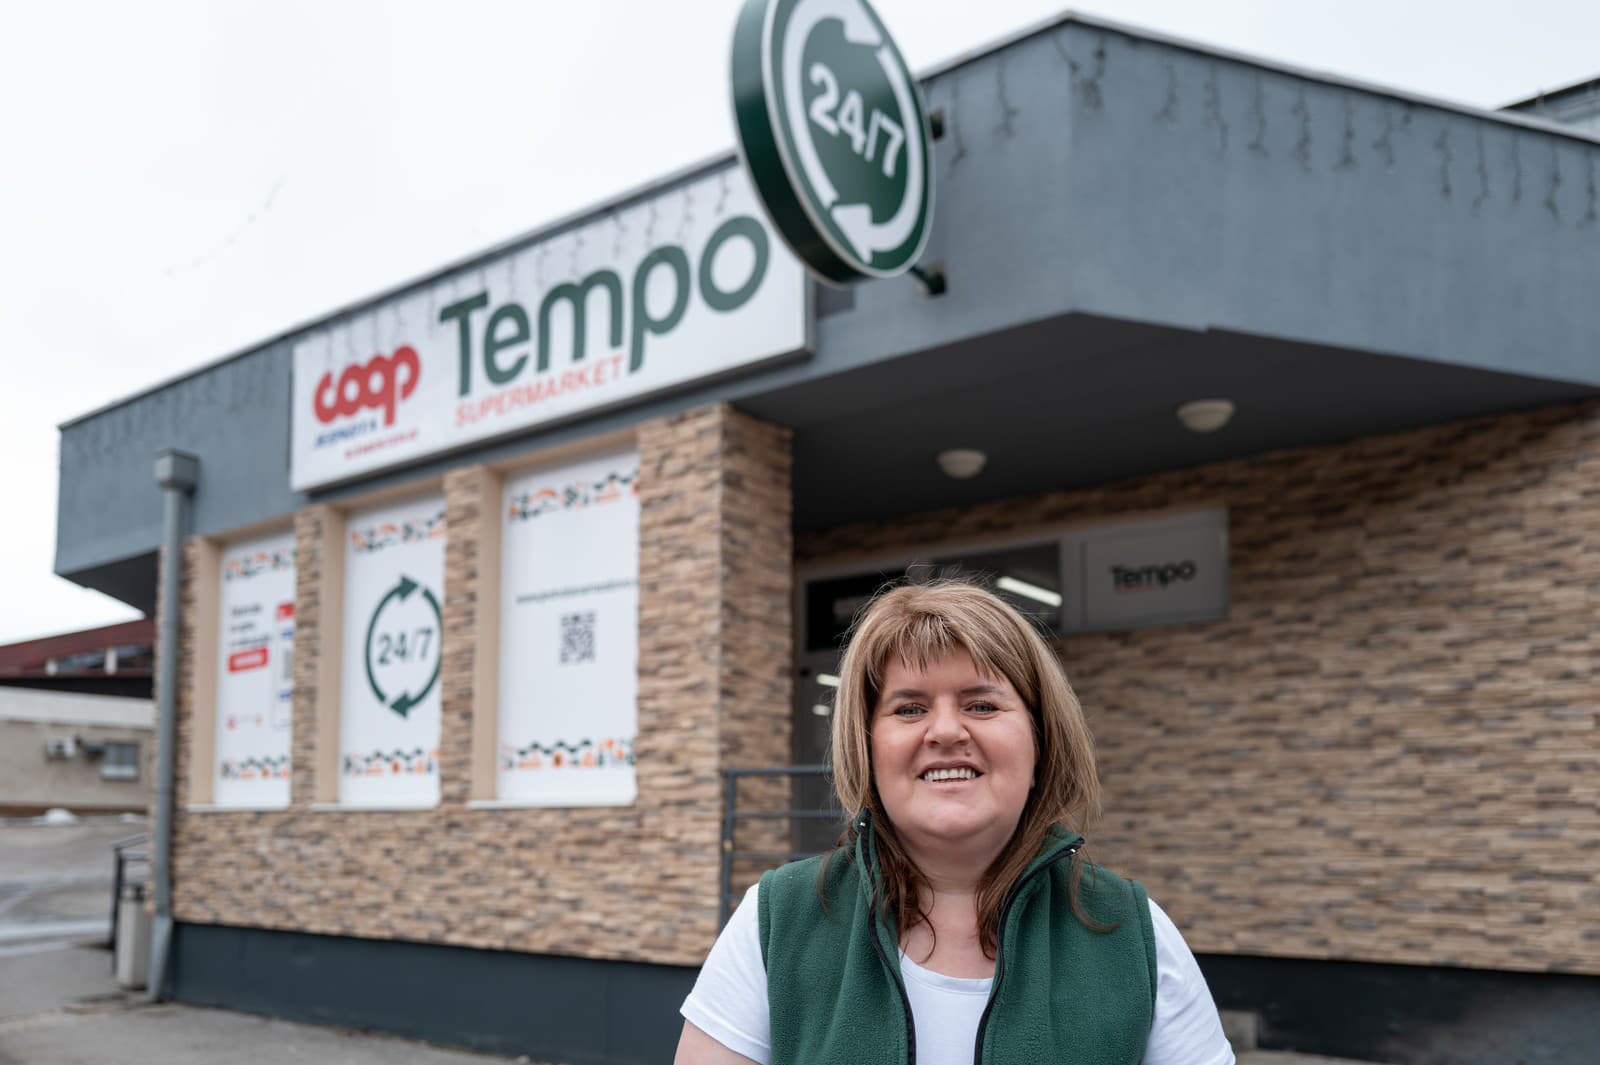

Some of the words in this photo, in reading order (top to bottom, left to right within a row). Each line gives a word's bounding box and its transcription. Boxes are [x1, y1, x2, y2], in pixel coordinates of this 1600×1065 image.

[809, 61, 905, 177] 24/7
[440, 214, 771, 396] Tempo
[314, 344, 421, 427] coop
[454, 354, 624, 429] SUPERMARKET
[1110, 560, 1196, 588] Tempo
[377, 628, 434, 666] 24/7
